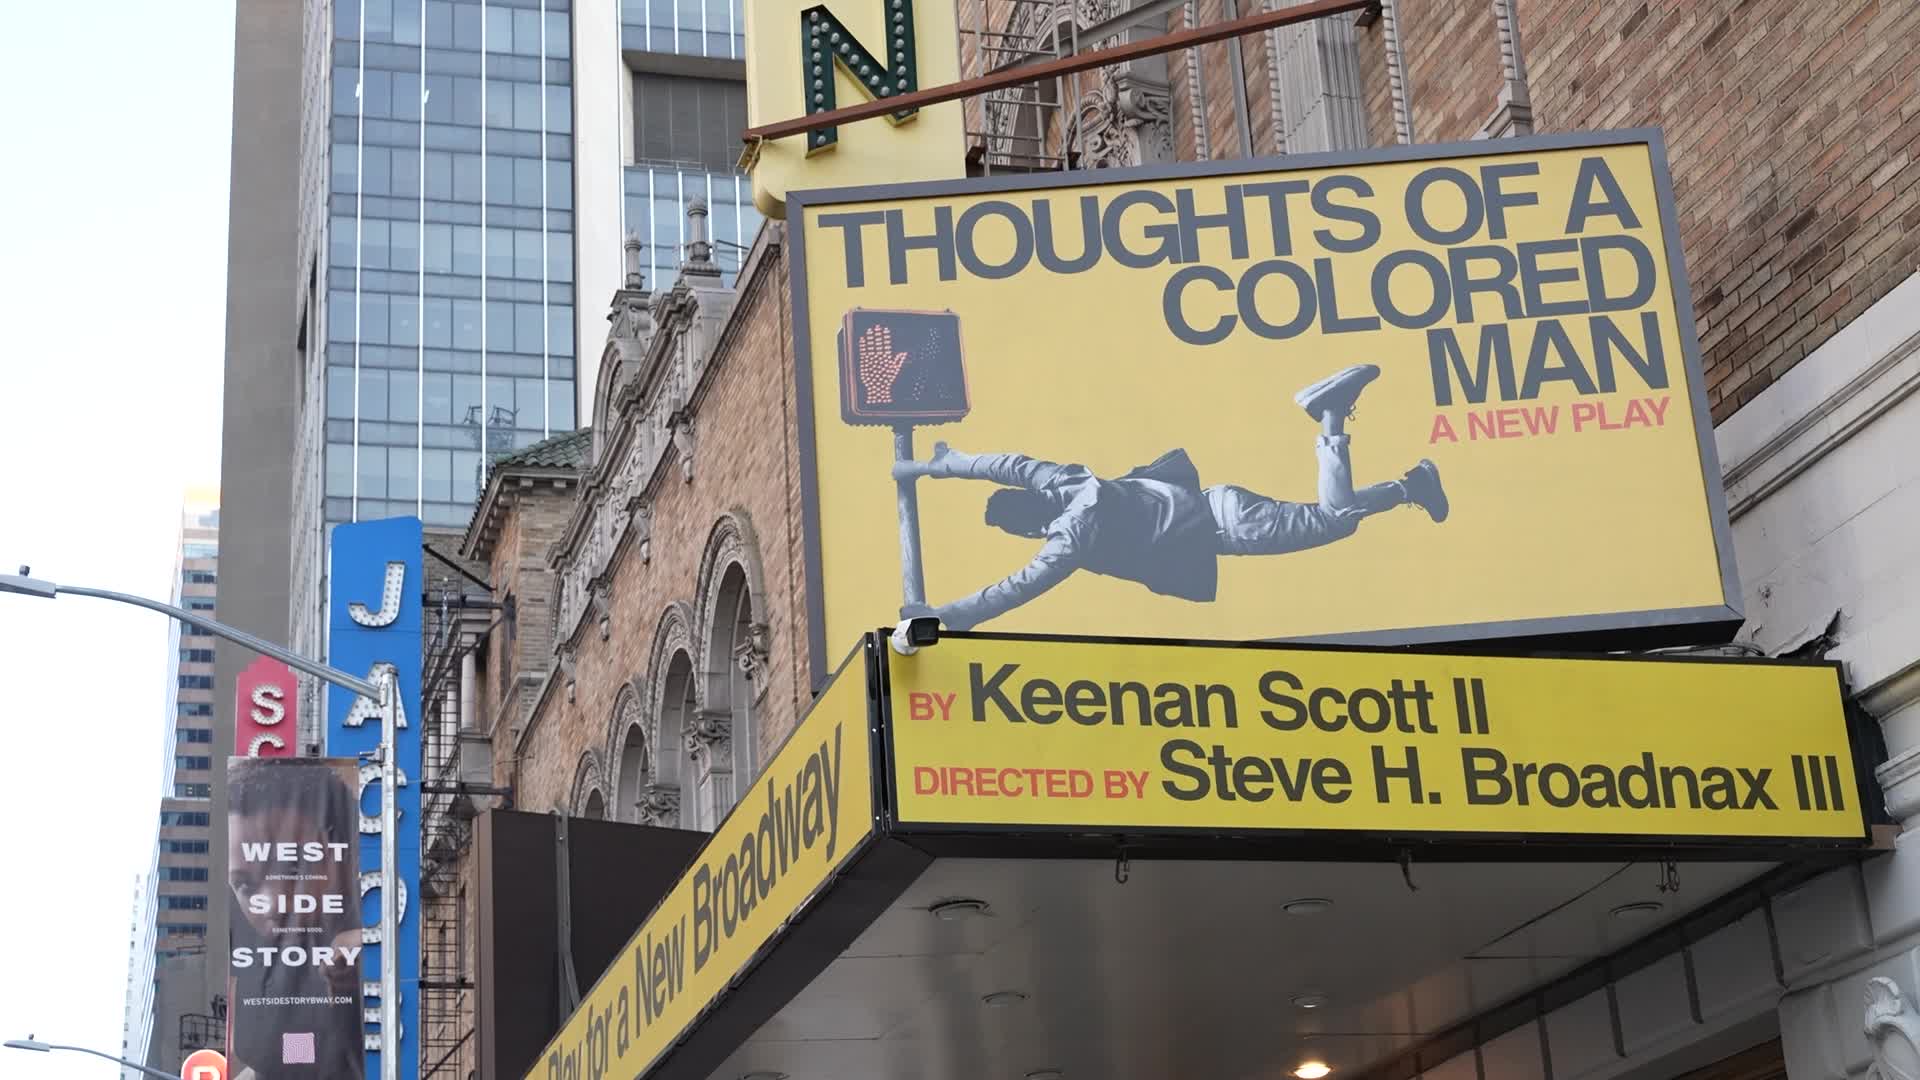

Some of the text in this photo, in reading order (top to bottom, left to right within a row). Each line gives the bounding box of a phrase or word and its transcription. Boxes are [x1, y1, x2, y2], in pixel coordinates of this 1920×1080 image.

[818, 156, 1642, 289] THOUGHTS OF A
[1163, 235, 1656, 346] COLORED
[1427, 312, 1669, 406] MAN
[1429, 397, 1671, 444] A NEW PLAY
[909, 662, 1490, 735] BY Keenan Scott II
[913, 739, 1845, 811] DIRECTED BY Steve H. Broadnax III
[241, 842, 349, 862] WEST
[249, 894, 344, 914] SIDE
[586, 722, 843, 1080] for a New Broadway
[231, 946, 362, 968] STORY
[243, 995, 353, 1006] WESTSIDESTORYBWAY.COM
